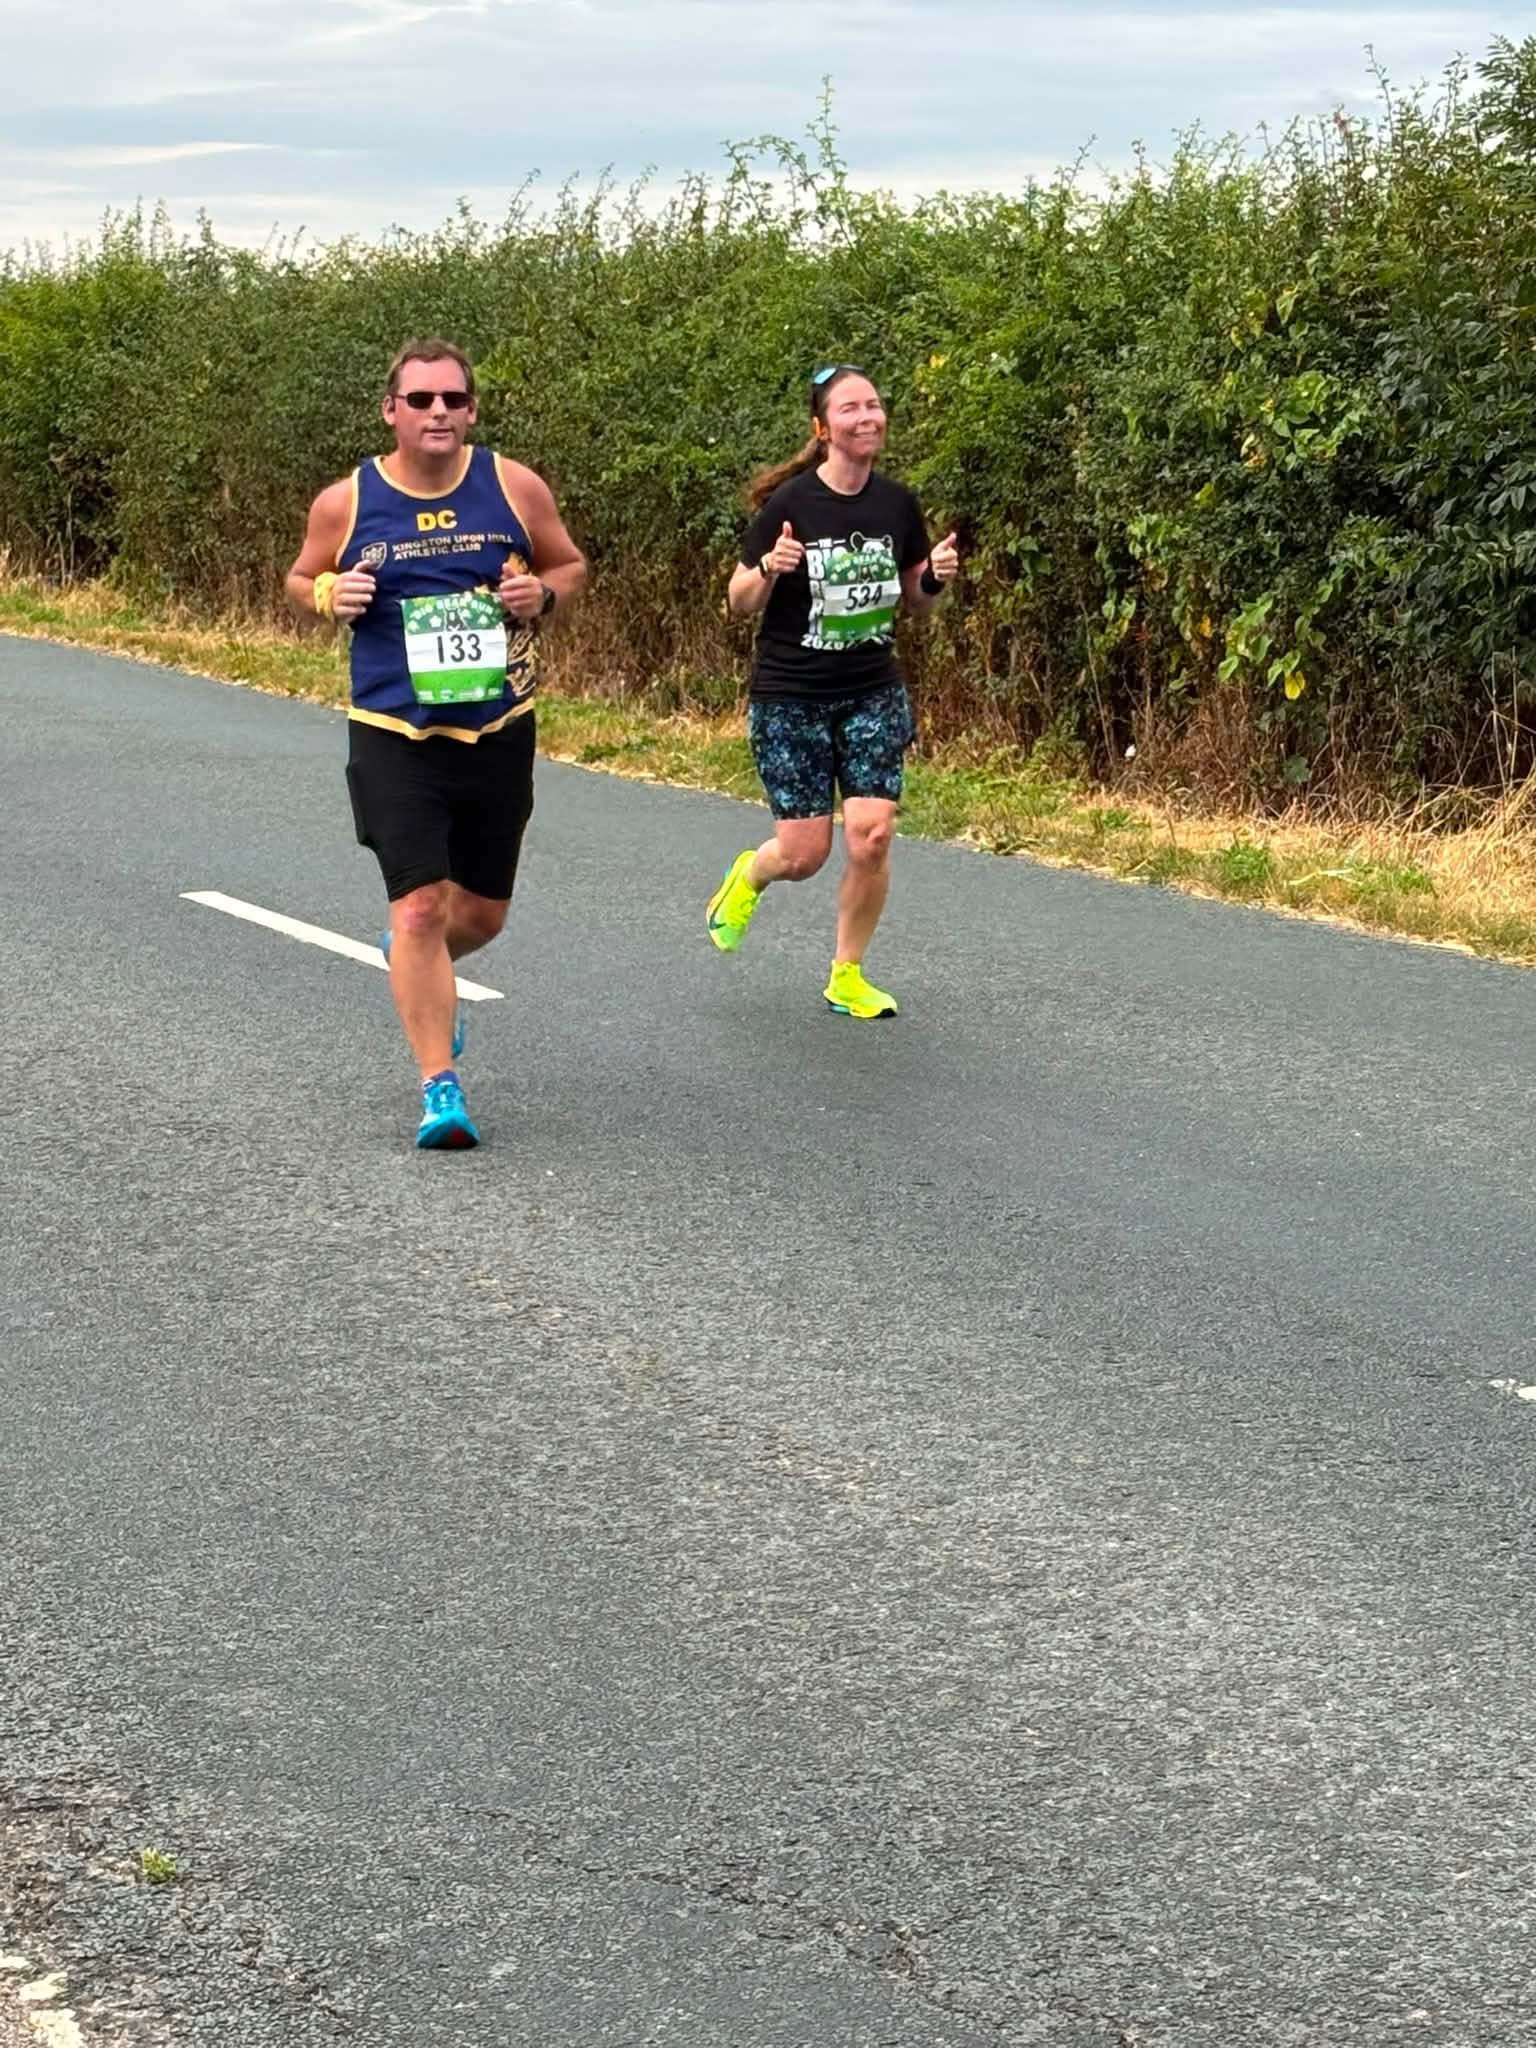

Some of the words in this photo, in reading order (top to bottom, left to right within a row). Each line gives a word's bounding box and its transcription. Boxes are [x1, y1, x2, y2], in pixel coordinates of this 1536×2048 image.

[416, 510, 458, 531] DC
[392, 535, 451, 552] KINGSTON
[454, 533, 485, 544] UPON
[394, 545, 448, 560] ATHLETIC
[451, 542, 481, 553] CLUB
[845, 584, 882, 611] 534
[436, 633, 482, 664] 133
